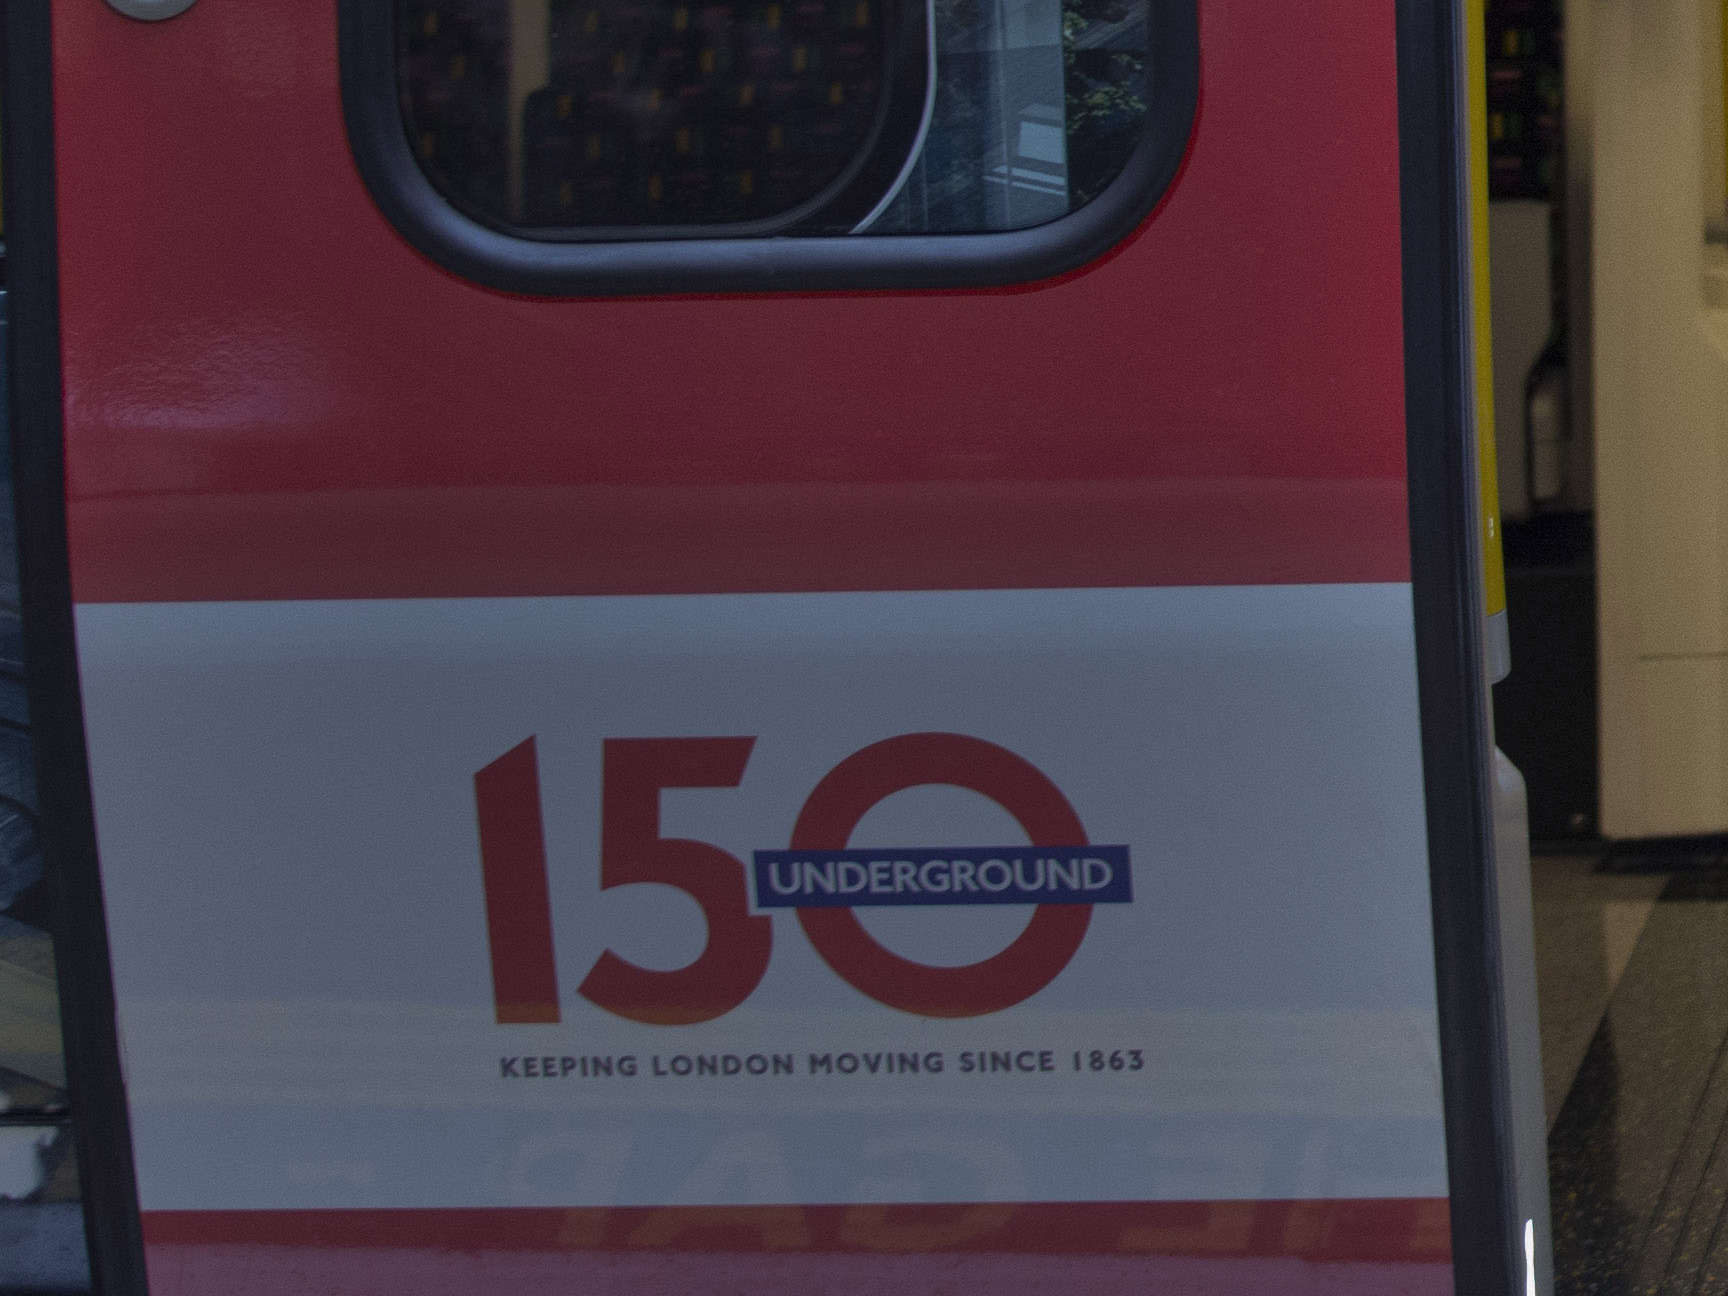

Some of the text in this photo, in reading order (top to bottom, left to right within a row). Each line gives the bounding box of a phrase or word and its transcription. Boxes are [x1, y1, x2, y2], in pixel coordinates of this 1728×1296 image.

[767, 856, 1114, 897] UNDERGROUND
[500, 1048, 1146, 1079] KEEPING LONDON MOVING SINCE 1863
